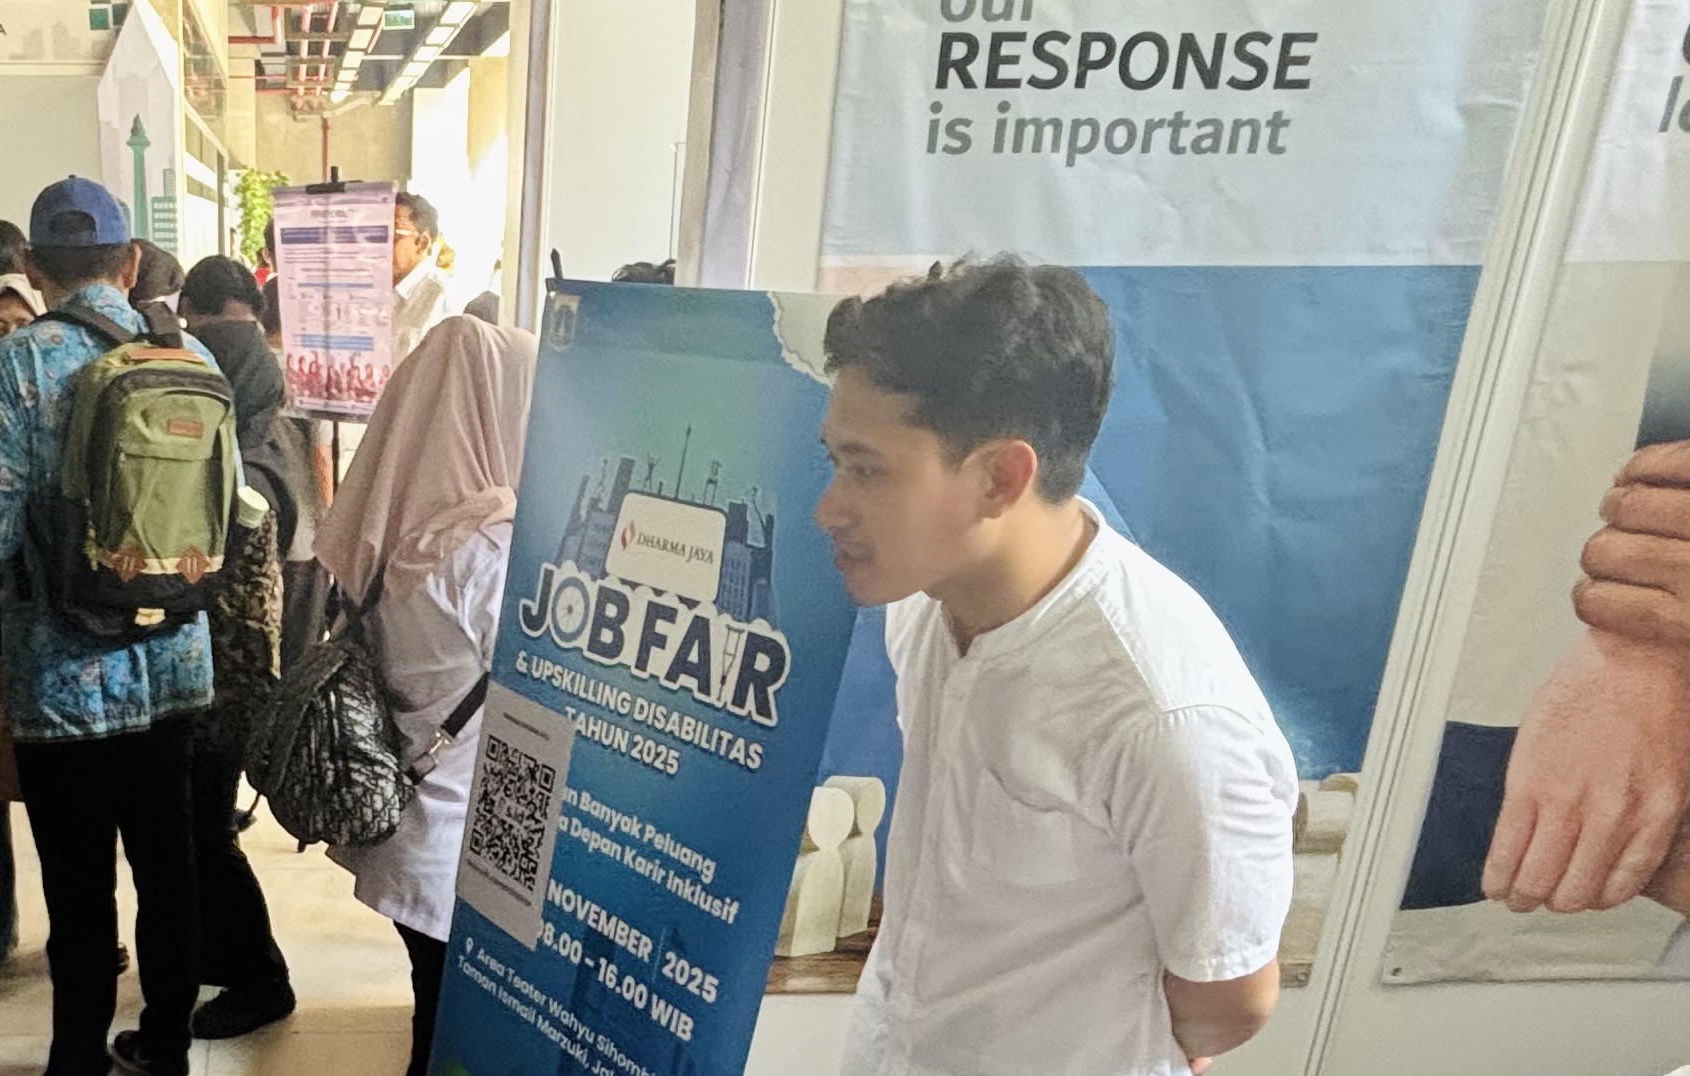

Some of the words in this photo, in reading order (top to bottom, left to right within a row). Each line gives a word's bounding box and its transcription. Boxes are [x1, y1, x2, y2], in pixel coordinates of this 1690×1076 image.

[935, 31, 1319, 91] RESPONSE
[925, 101, 973, 155] is
[992, 101, 1291, 168] important
[636, 532, 686, 557] DHARMA
[686, 545, 714, 565] JAYA
[515, 650, 529, 674] &
[532, 655, 631, 715] UPSKILLING
[633, 697, 763, 770] DISABILITAS
[565, 706, 630, 754] TAHUN
[630, 735, 680, 776] 2025
[570, 815, 622, 861] Depan
[623, 846, 667, 884] Karir
[666, 871, 740, 924] Inklusif
[579, 791, 643, 839] Banyak
[643, 824, 717, 885] Peluang
[539, 918, 583, 965] 8.00
[597, 957, 648, 1010] 16.00
[651, 993, 695, 1041] WIB
[547, 879, 653, 963] NOVEMBER
[662, 951, 719, 1004] 2025
[458, 955, 497, 994] Taman
[497, 987, 536, 1025] Ismail
[536, 1014, 590, 1069] Marzuki,
[476, 948, 506, 977] Area
[506, 967, 548, 1004] Teater
[548, 998, 596, 1044] Wahyu
